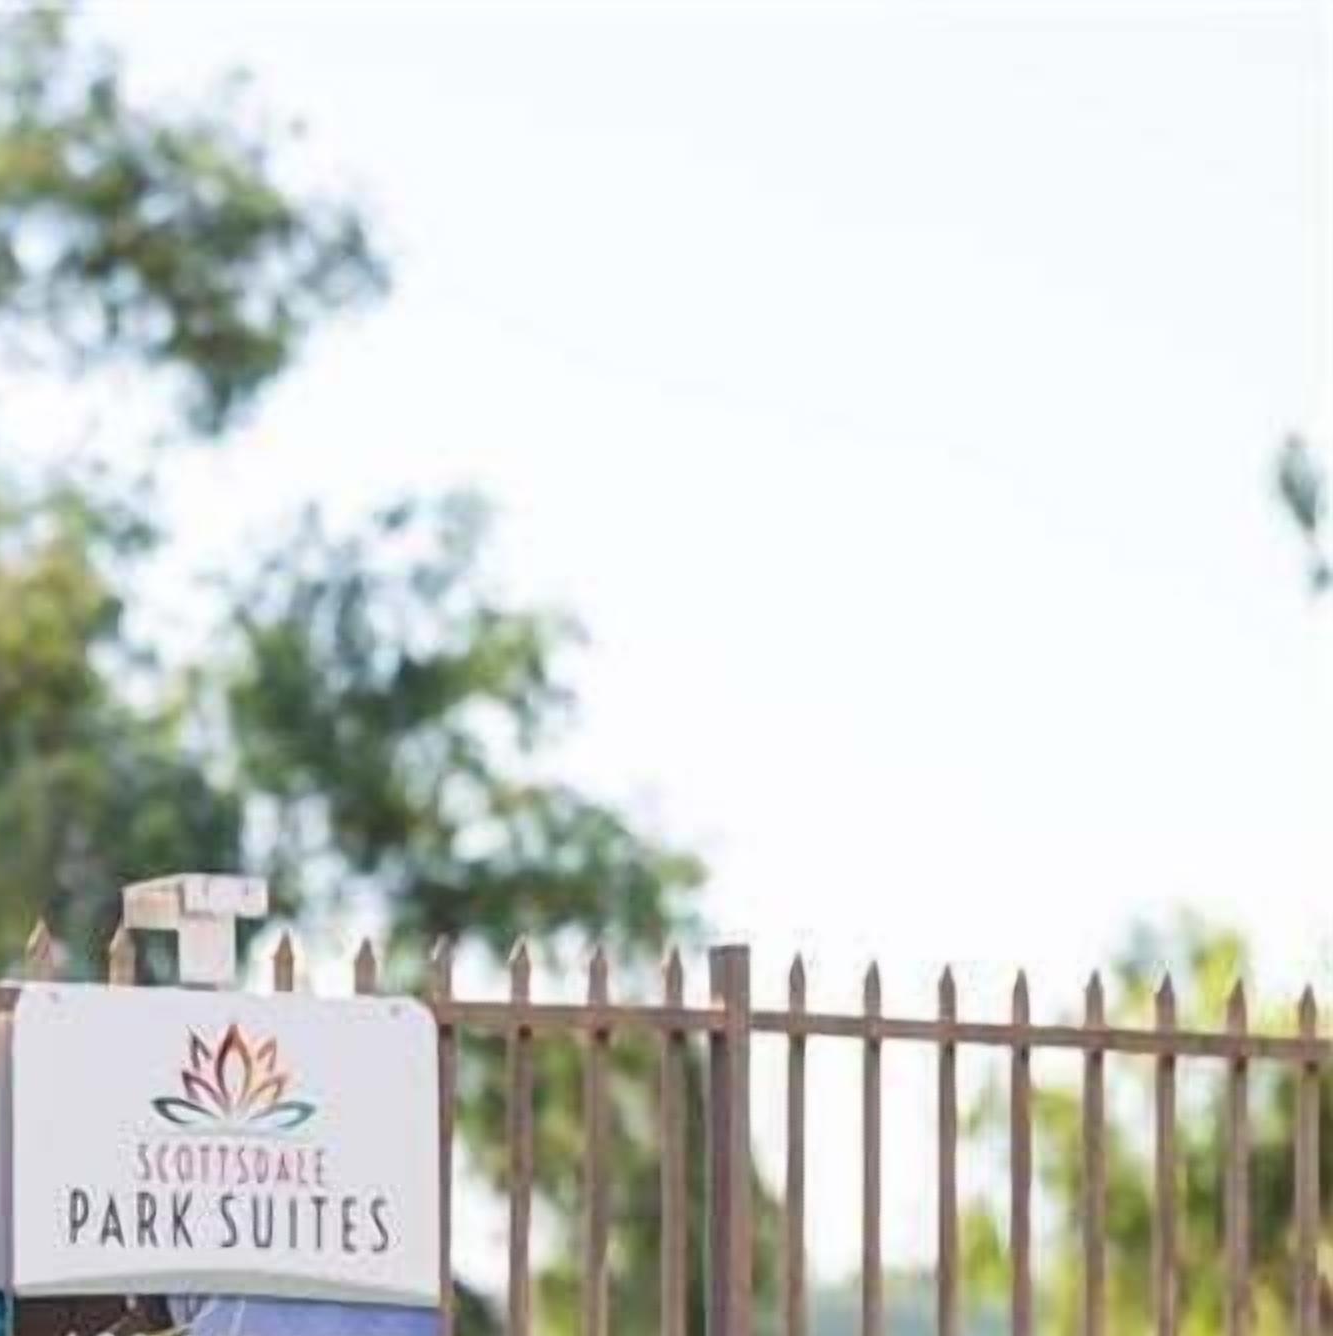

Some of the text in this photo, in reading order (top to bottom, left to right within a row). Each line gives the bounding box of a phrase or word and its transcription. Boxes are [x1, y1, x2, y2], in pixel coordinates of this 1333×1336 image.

[137, 1143, 326, 1186] SCOTTSDALE
[69, 1188, 389, 1252] PARK SUITES
